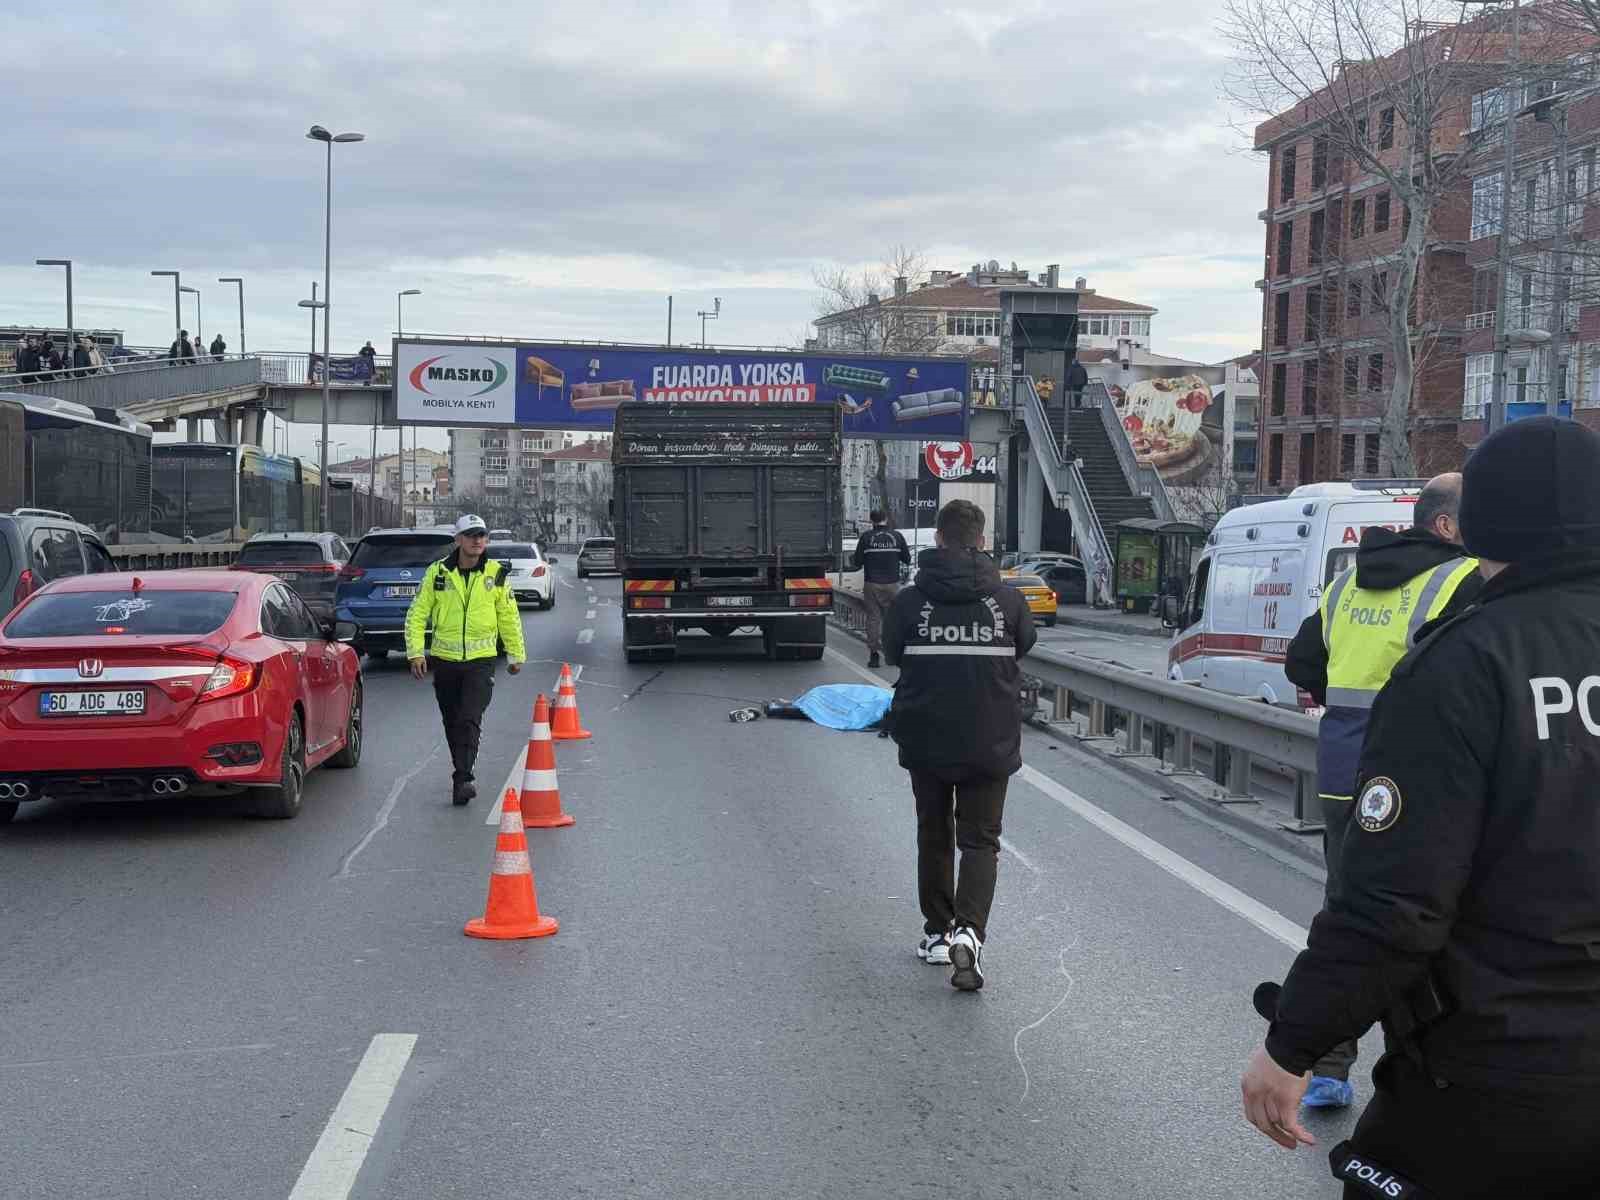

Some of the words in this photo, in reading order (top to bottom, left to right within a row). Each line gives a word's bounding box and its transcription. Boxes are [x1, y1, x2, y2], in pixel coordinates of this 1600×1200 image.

[428, 366, 494, 383] MASKO
[652, 365, 733, 389] FUARDA
[739, 362, 805, 386] YOKSA
[975, 456, 997, 474] 44
[918, 601, 934, 637] OLAY
[1264, 600, 1278, 630] 112
[1350, 604, 1393, 626] POLİS
[930, 621, 993, 642] POLİS
[50, 694, 67, 710] 60
[80, 693, 105, 709] ADG
[117, 692, 143, 709] 489
[1345, 1160, 1402, 1197] POLİS
